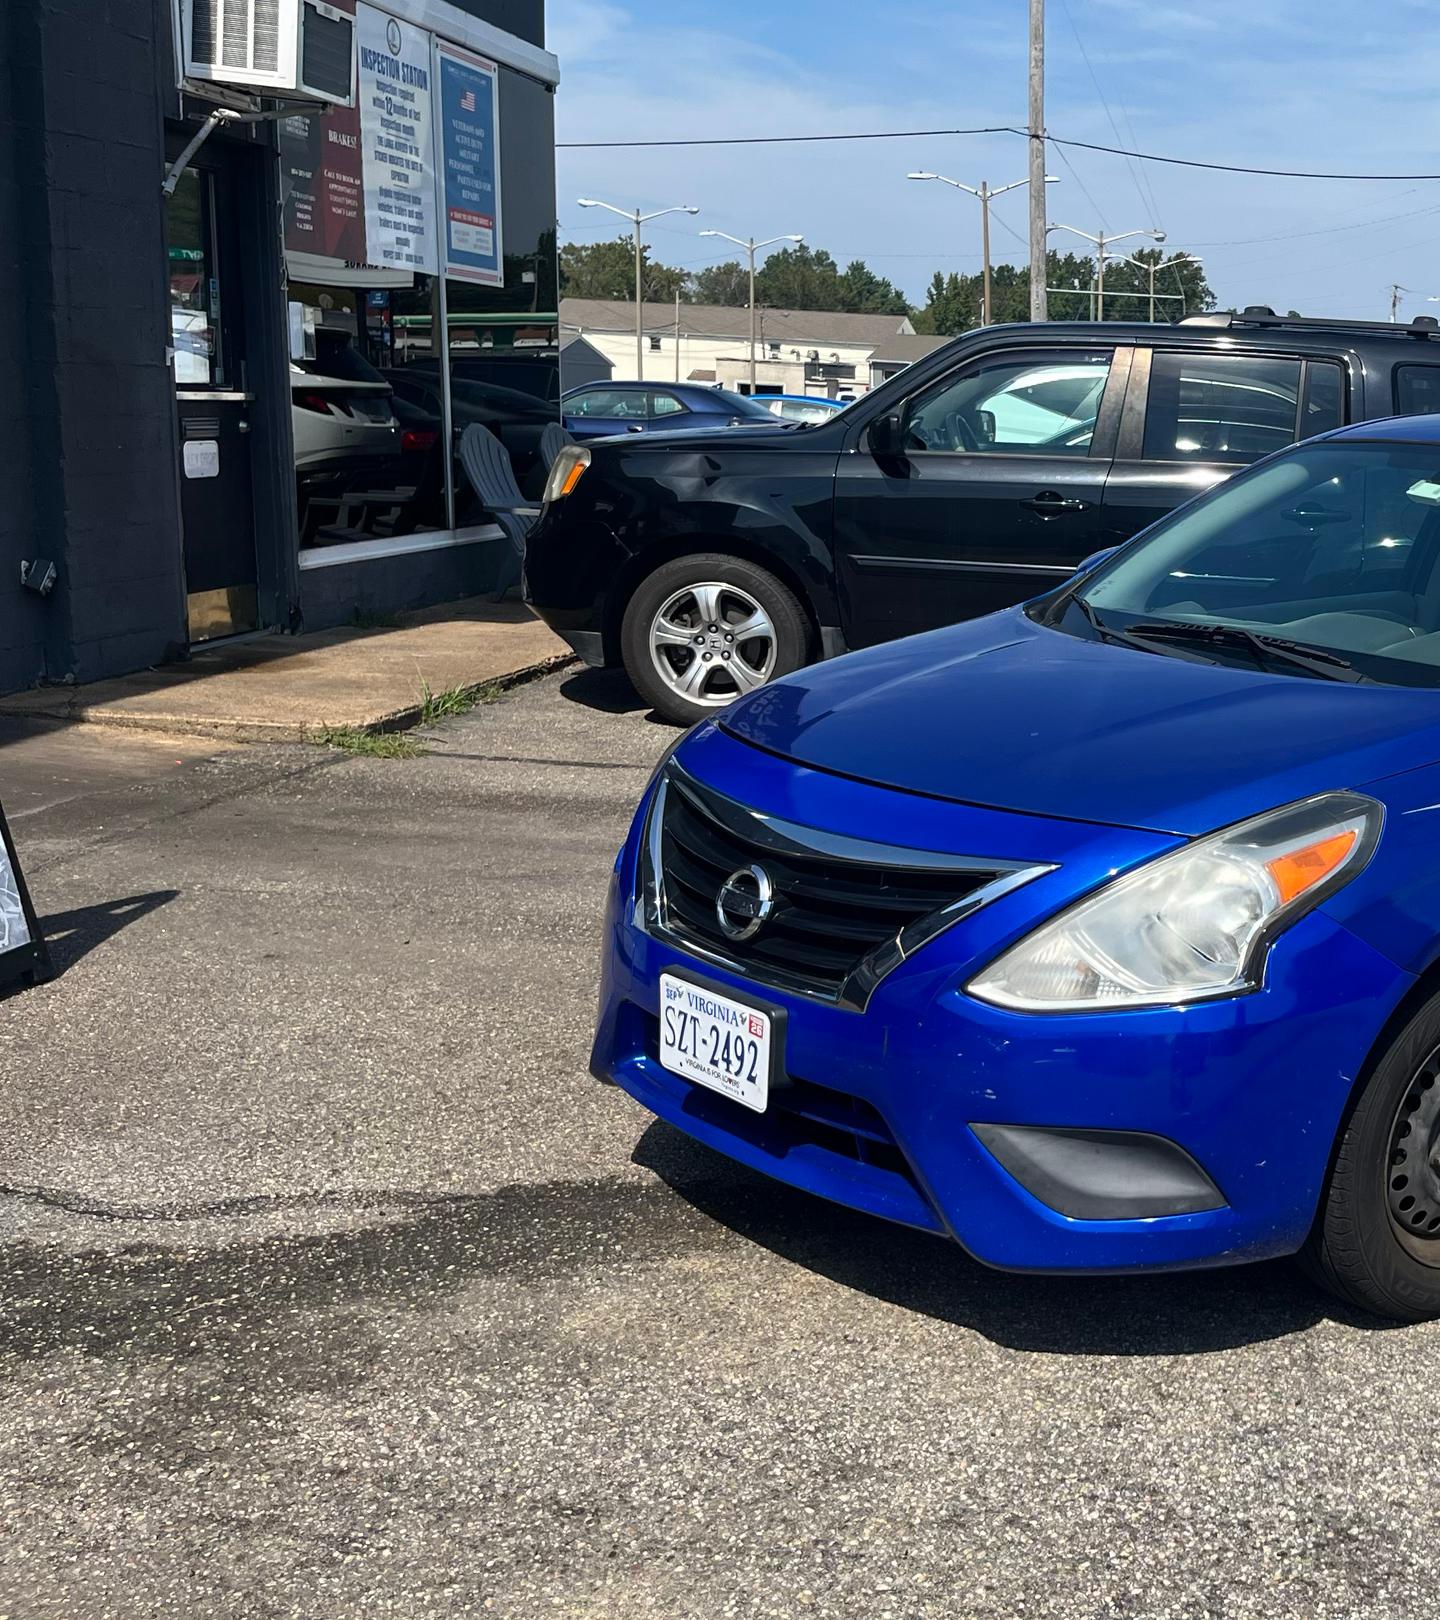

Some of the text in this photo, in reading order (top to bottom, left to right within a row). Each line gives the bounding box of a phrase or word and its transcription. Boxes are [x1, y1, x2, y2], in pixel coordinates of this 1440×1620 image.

[361, 46, 400, 81] INSPECTION
[401, 61, 428, 92] STATION
[385, 95, 393, 116] 12
[328, 130, 357, 149] BRAKES!
[666, 987, 678, 1001] SEP
[687, 992, 740, 1028] VIRGINIA
[751, 1022, 763, 1037] 26
[665, 1006, 759, 1085] SZT-2492
[685, 1058, 706, 1073] VIRGINIA
